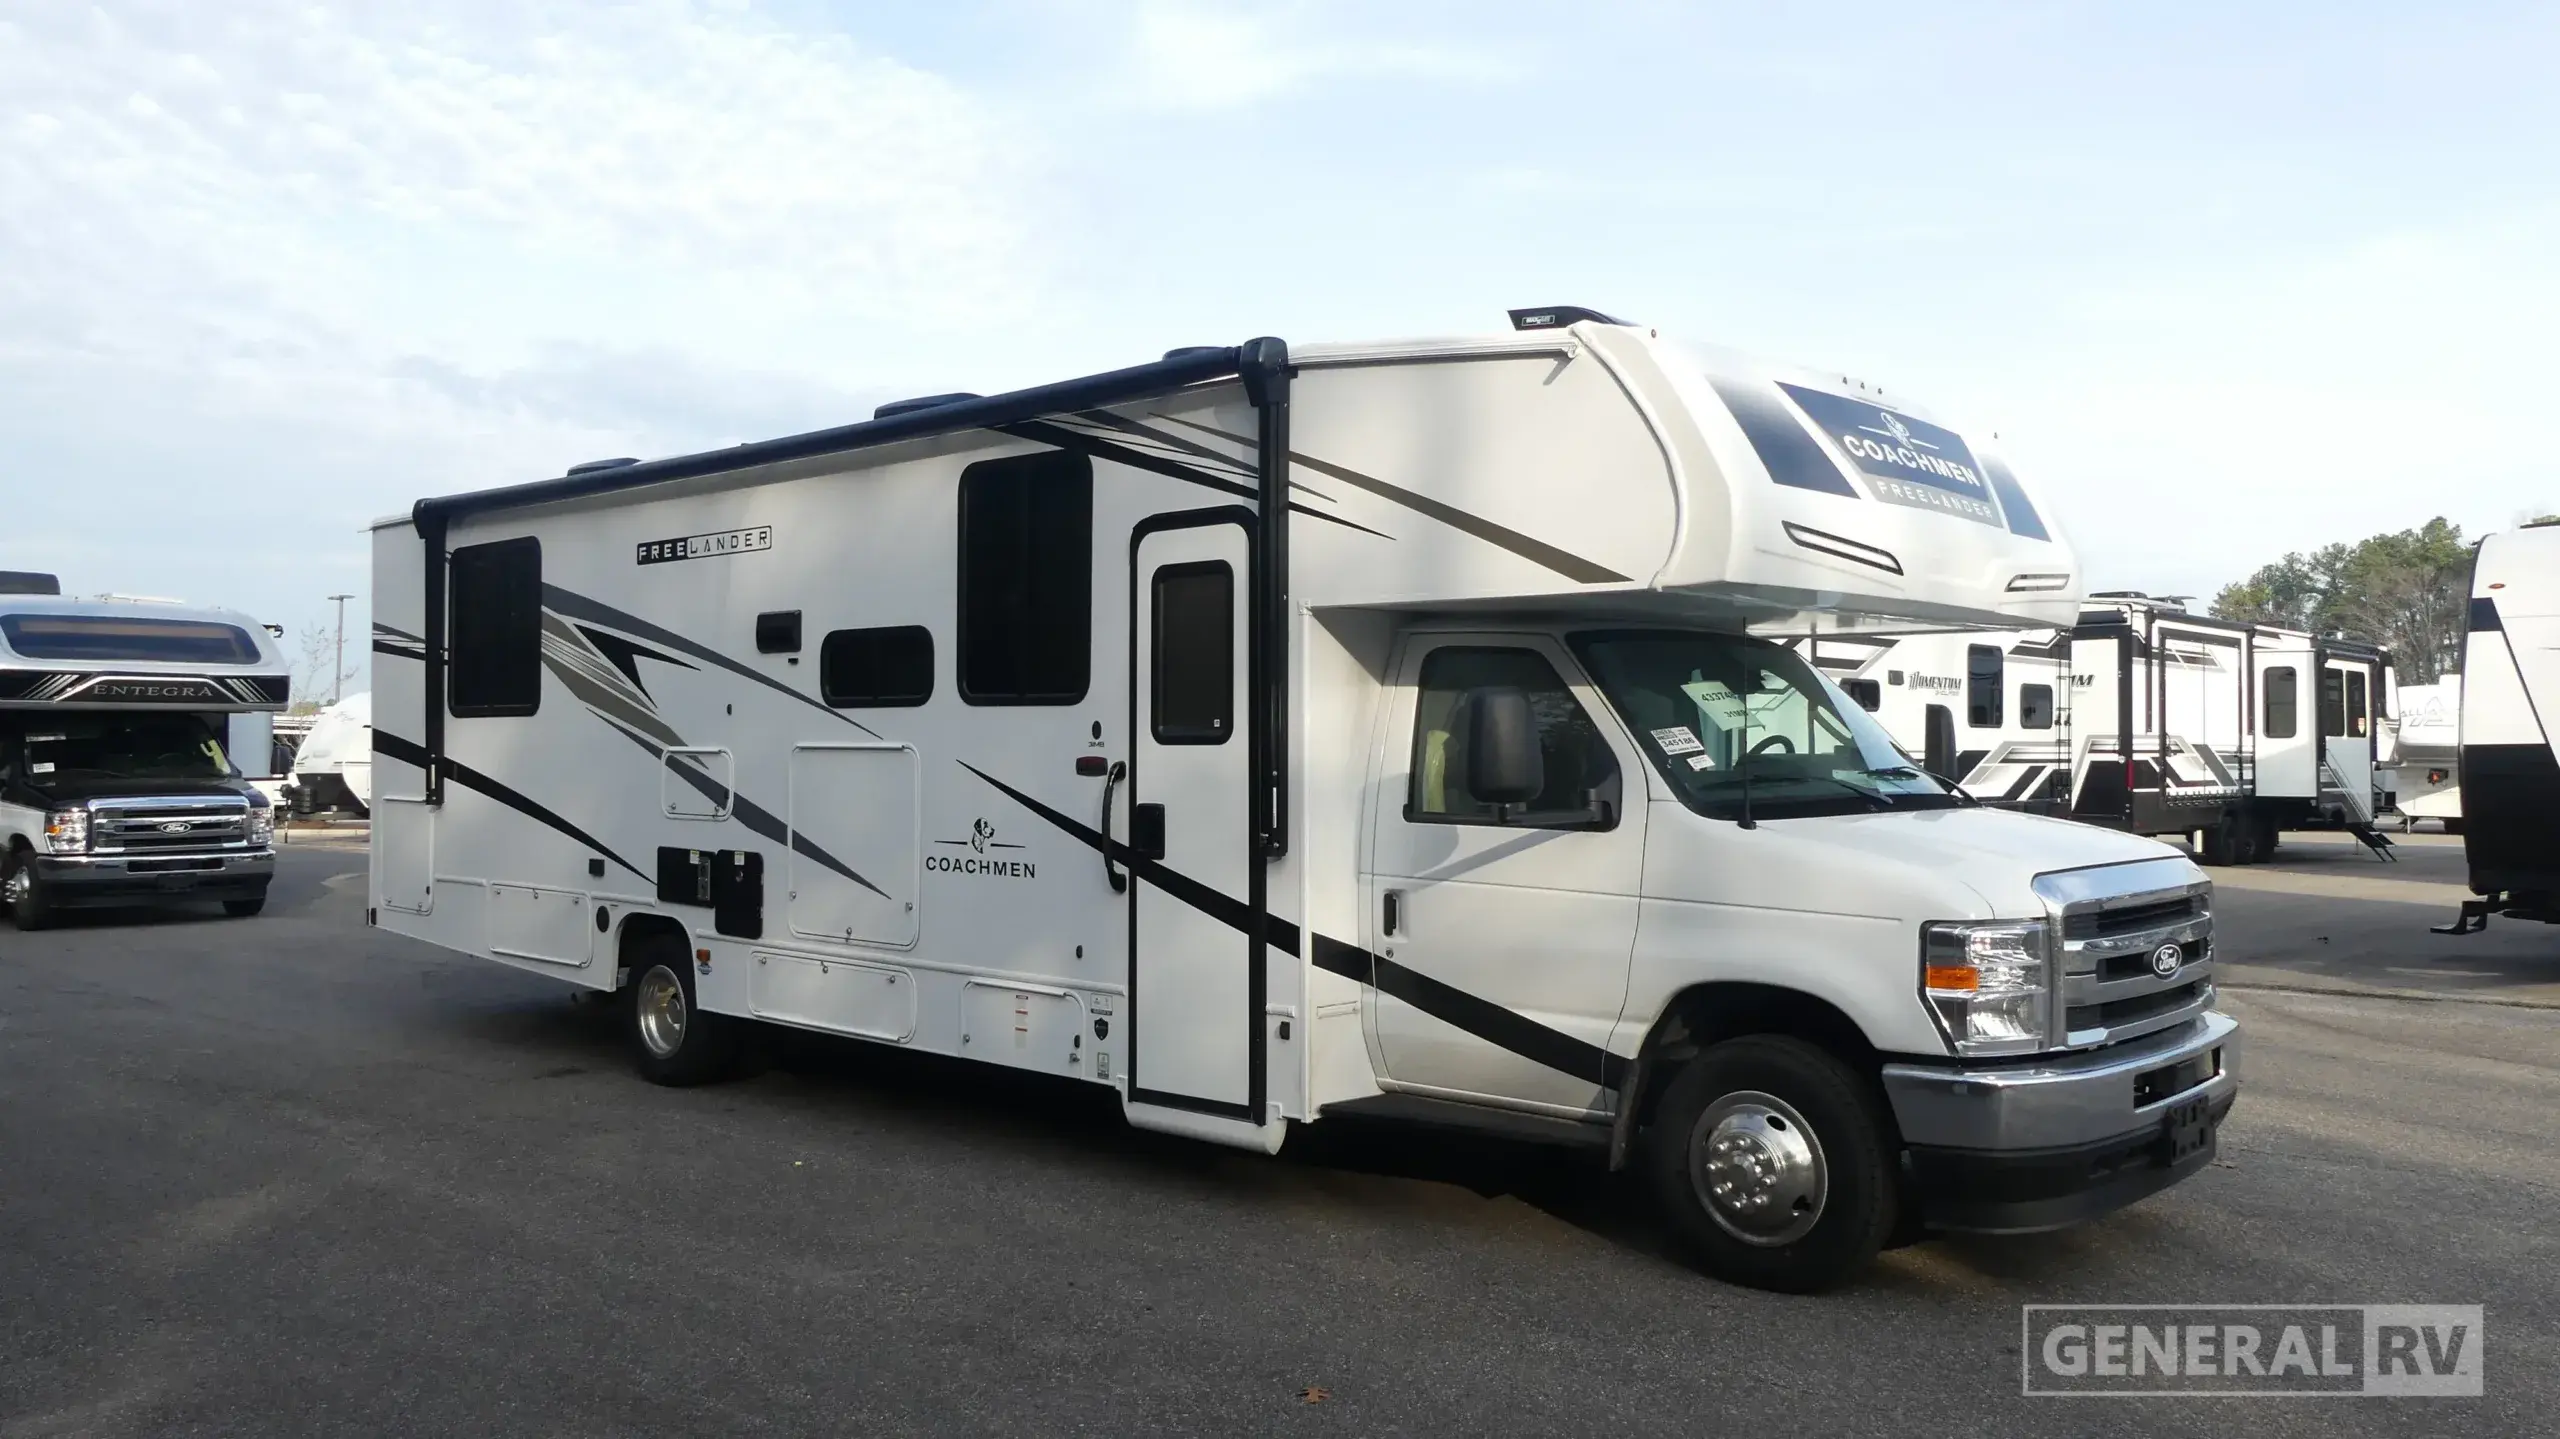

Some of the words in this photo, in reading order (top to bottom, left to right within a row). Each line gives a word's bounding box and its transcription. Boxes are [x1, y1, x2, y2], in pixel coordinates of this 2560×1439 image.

[1843, 434, 1981, 487] COACHMEN
[1876, 480, 1993, 520] FREELANDER
[638, 530, 768, 561] FREELANDER
[92, 684, 213, 697] ENTEGRA
[1908, 671, 1962, 690] MOMENTUM
[925, 856, 1035, 879] COACHMEN
[2158, 948, 2178, 971] Ford
